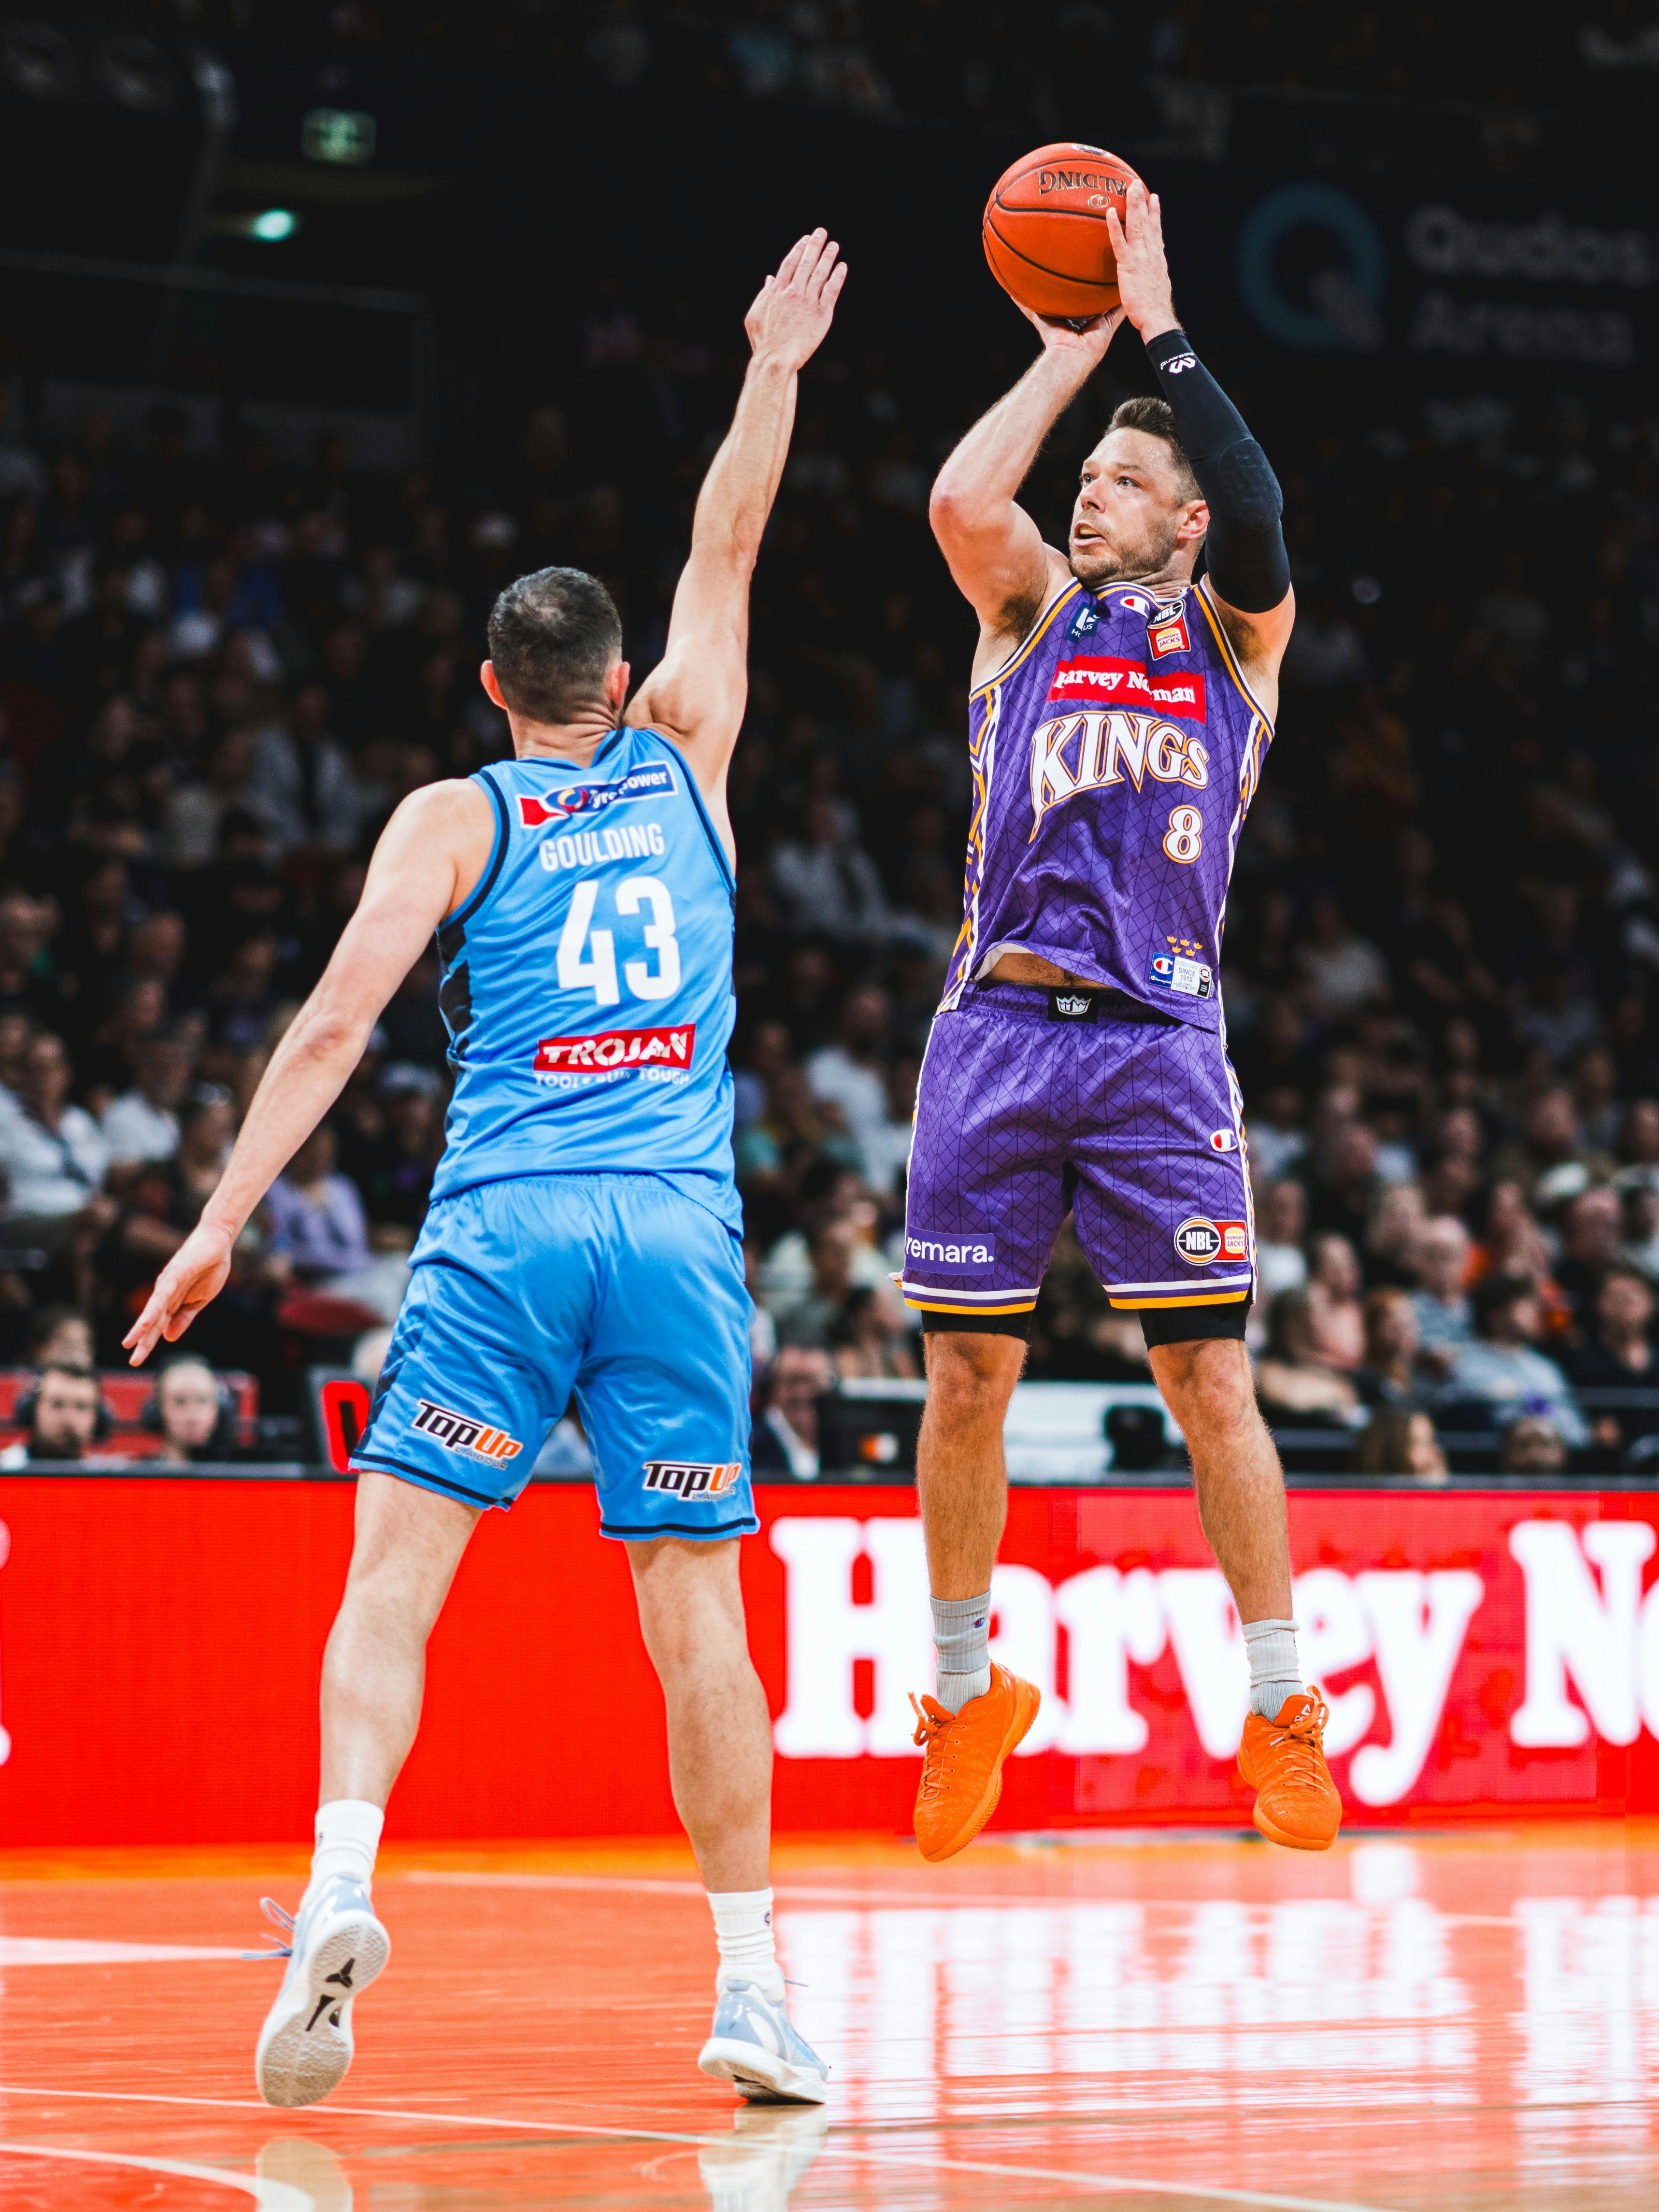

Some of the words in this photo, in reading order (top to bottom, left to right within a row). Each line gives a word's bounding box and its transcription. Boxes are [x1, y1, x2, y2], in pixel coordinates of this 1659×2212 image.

[1040, 171, 1128, 197] ALDING
[1153, 606, 1175, 623] NBL
[1158, 633, 1179, 642] HUNGRY
[1126, 671, 1196, 704] Noman
[1029, 711, 1209, 844] KINGS
[539, 823, 665, 871] GOULDING
[1162, 805, 1202, 864] 8
[556, 876, 681, 1005] 43
[1178, 967, 1196, 977] SINCE
[543, 1032, 688, 1066] TROJAN
[1186, 1231, 1213, 1250] NBL
[414, 1401, 522, 1459] TopUp
[455, 1448, 507, 1470] LABOUR
